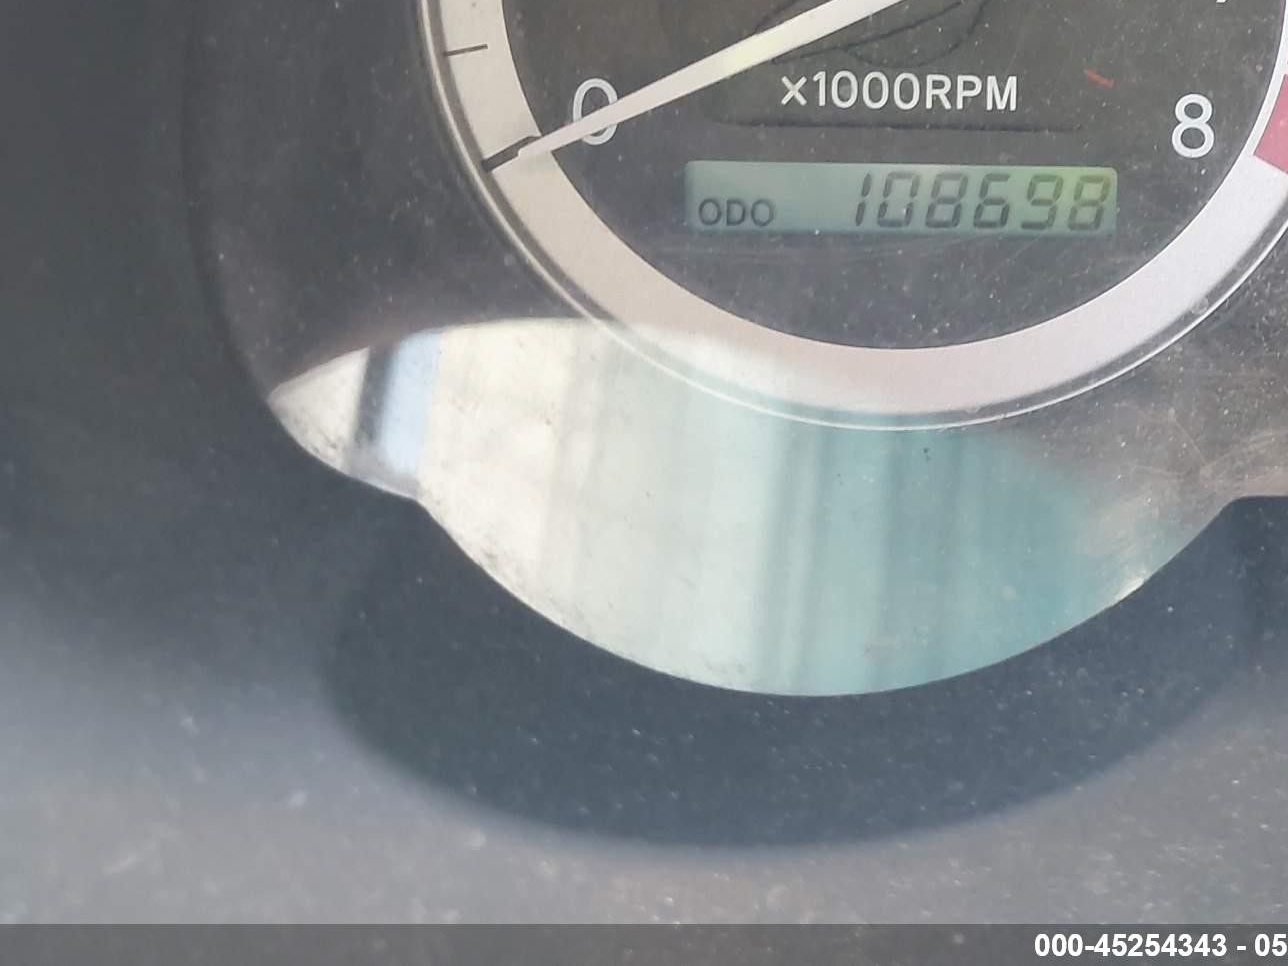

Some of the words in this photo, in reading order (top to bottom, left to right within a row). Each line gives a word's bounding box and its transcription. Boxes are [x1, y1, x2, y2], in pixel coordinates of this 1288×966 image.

[571, 78, 619, 146] 0
[1171, 94, 1214, 158] 8
[699, 199, 775, 227] ODO
[855, 171, 1112, 231] 108698
